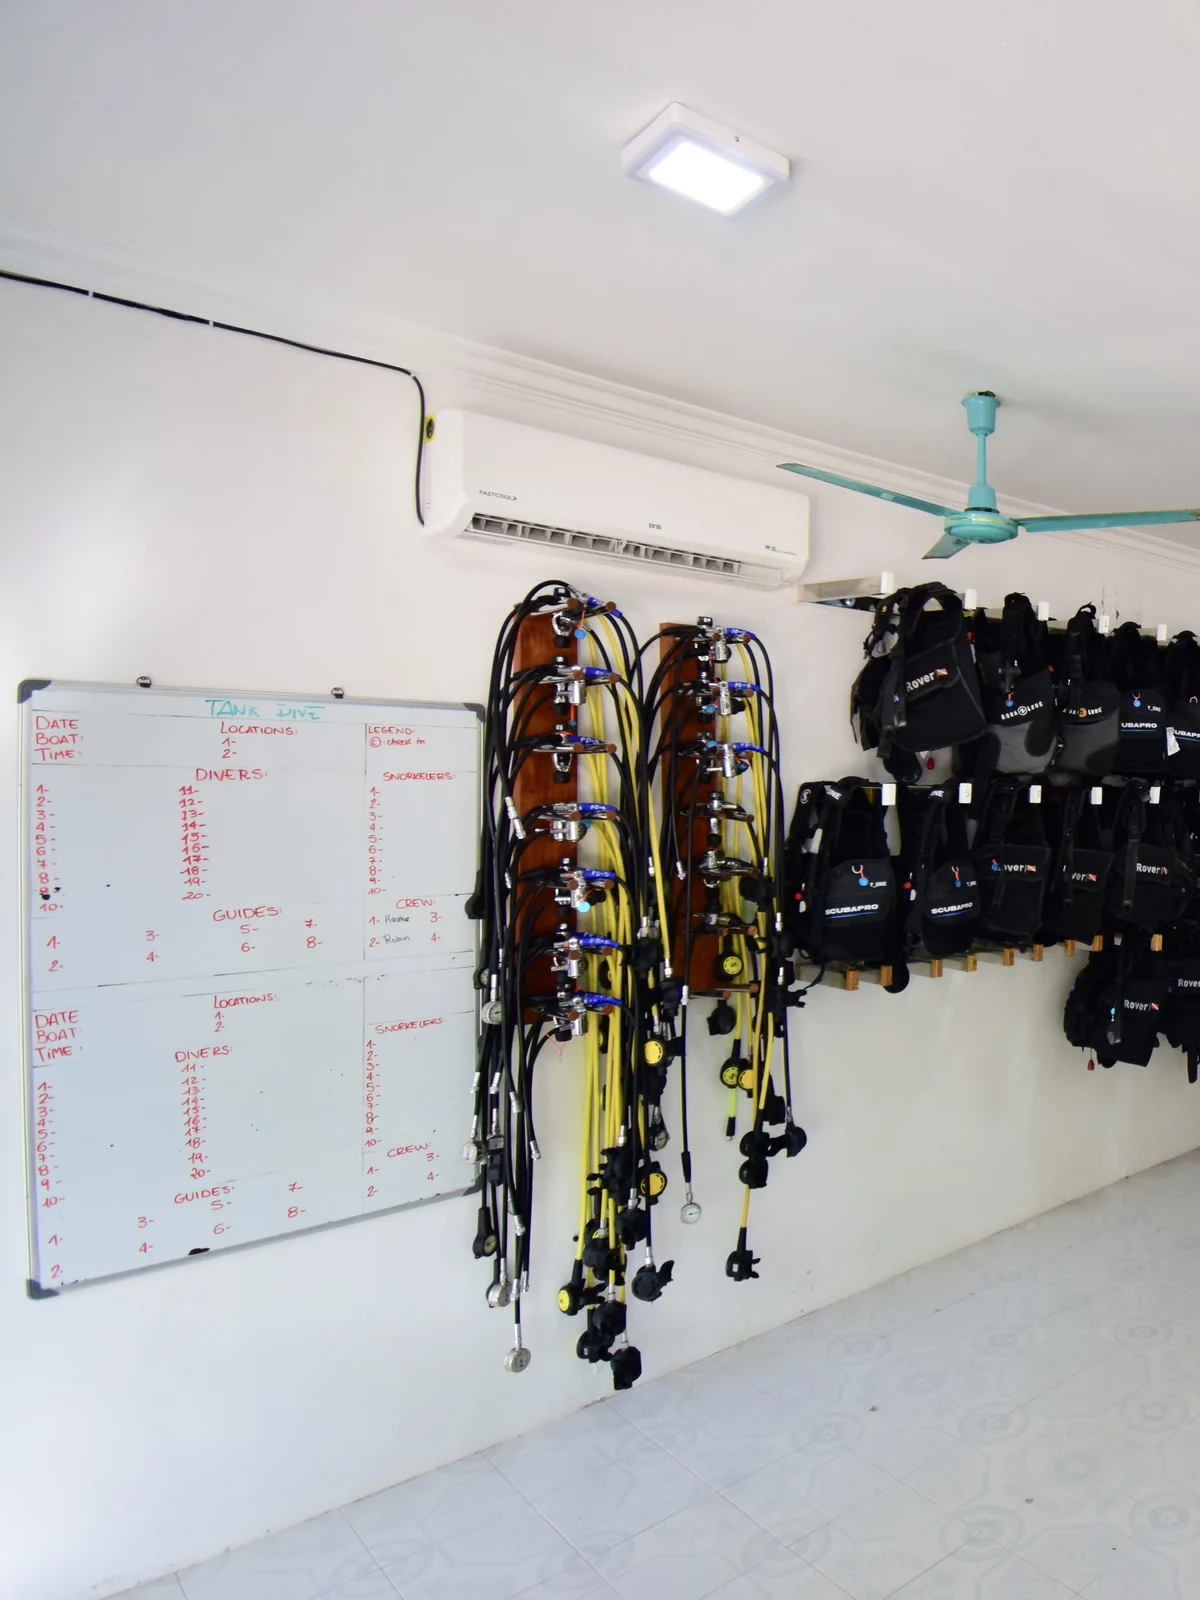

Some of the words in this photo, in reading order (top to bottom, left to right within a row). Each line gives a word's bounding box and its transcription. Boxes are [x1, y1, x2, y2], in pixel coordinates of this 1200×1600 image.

[479, 490, 512, 500] FASTCOOL
[205, 700, 260, 717] TANK
[35, 716, 78, 730] DATE
[220, 721, 298, 735] LOCATIONS:
[194, 768, 268, 783] DIVERS:
[1136, 863, 1161, 875] Rover
[396, 898, 436, 909] CREW:
[825, 904, 879, 916] SCUBAPRO
[931, 902, 973, 915] SCUBAPRO
[212, 906, 283, 922] GUIDES:
[214, 993, 277, 1009] LOCATIONS:
[1124, 1000, 1148, 1011] Rover
[35, 1010, 78, 1029] DATE
[174, 1046, 232, 1062] DIVERS:
[387, 1142, 432, 1157] CREW:
[173, 1186, 234, 1204] GUIDES:
